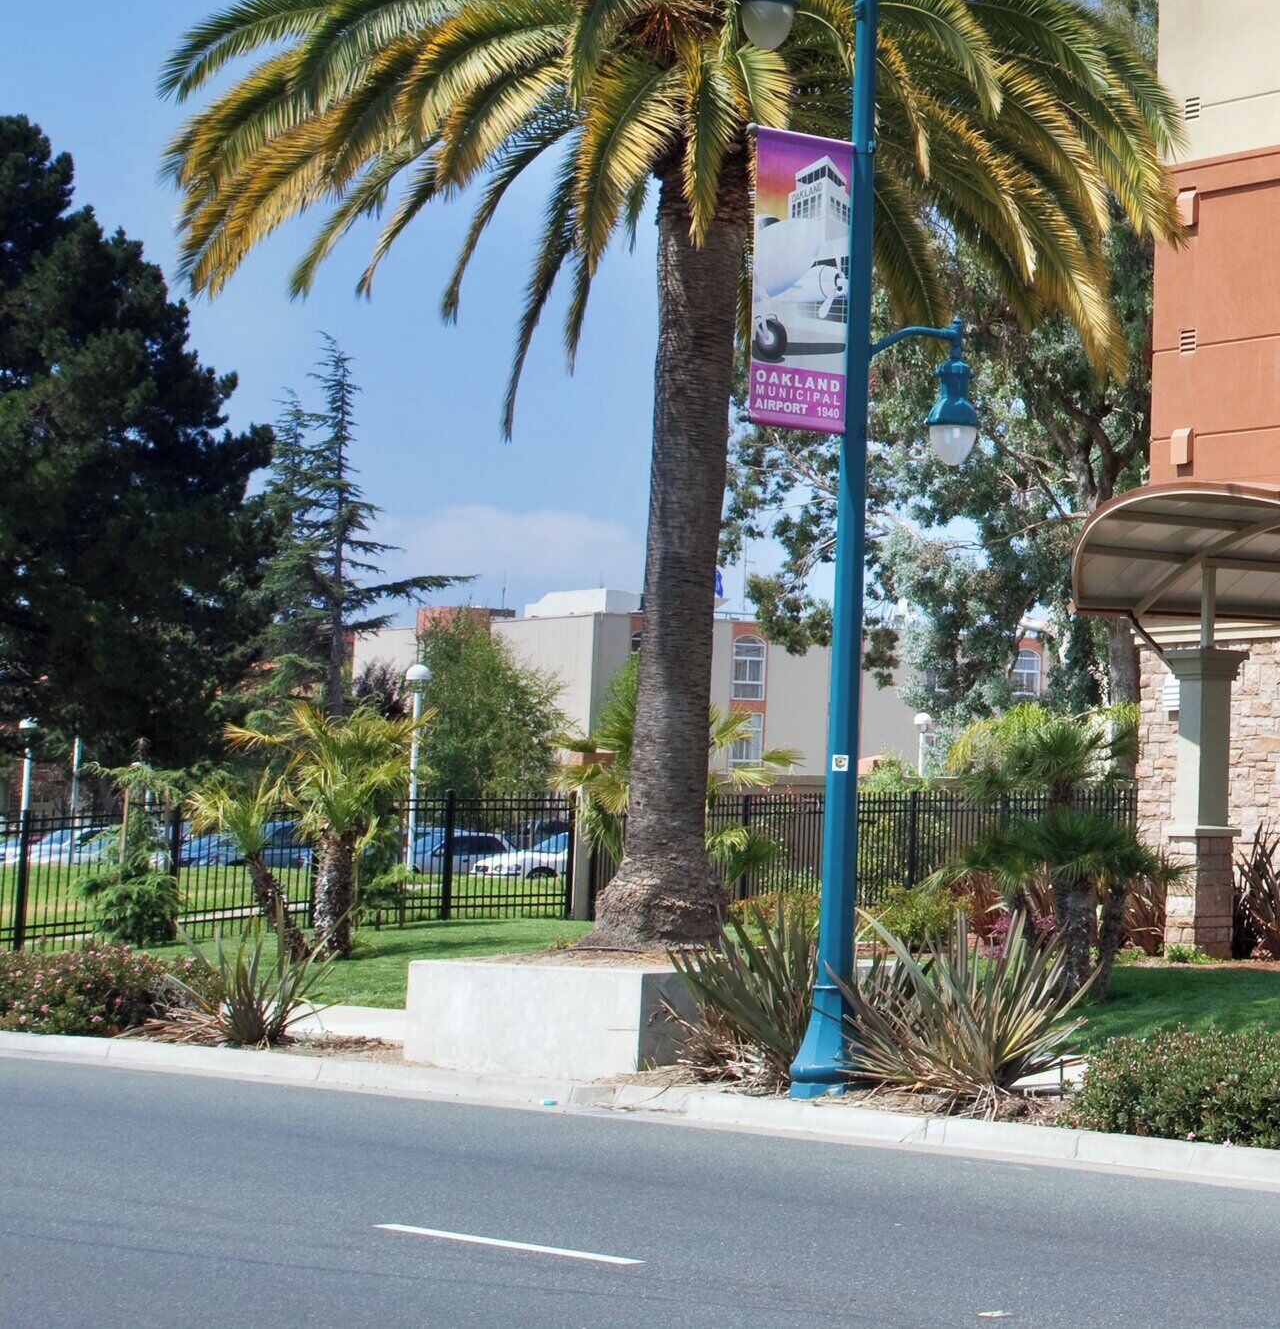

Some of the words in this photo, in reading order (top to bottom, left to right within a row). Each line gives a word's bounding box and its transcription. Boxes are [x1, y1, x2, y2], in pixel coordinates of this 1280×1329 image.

[791, 182, 823, 203] OAKLAND
[755, 370, 841, 392] OAKLAND
[755, 384, 841, 406] MUNICIPAL
[755, 398, 809, 415] AIRPORT
[816, 406, 840, 419] 1940
